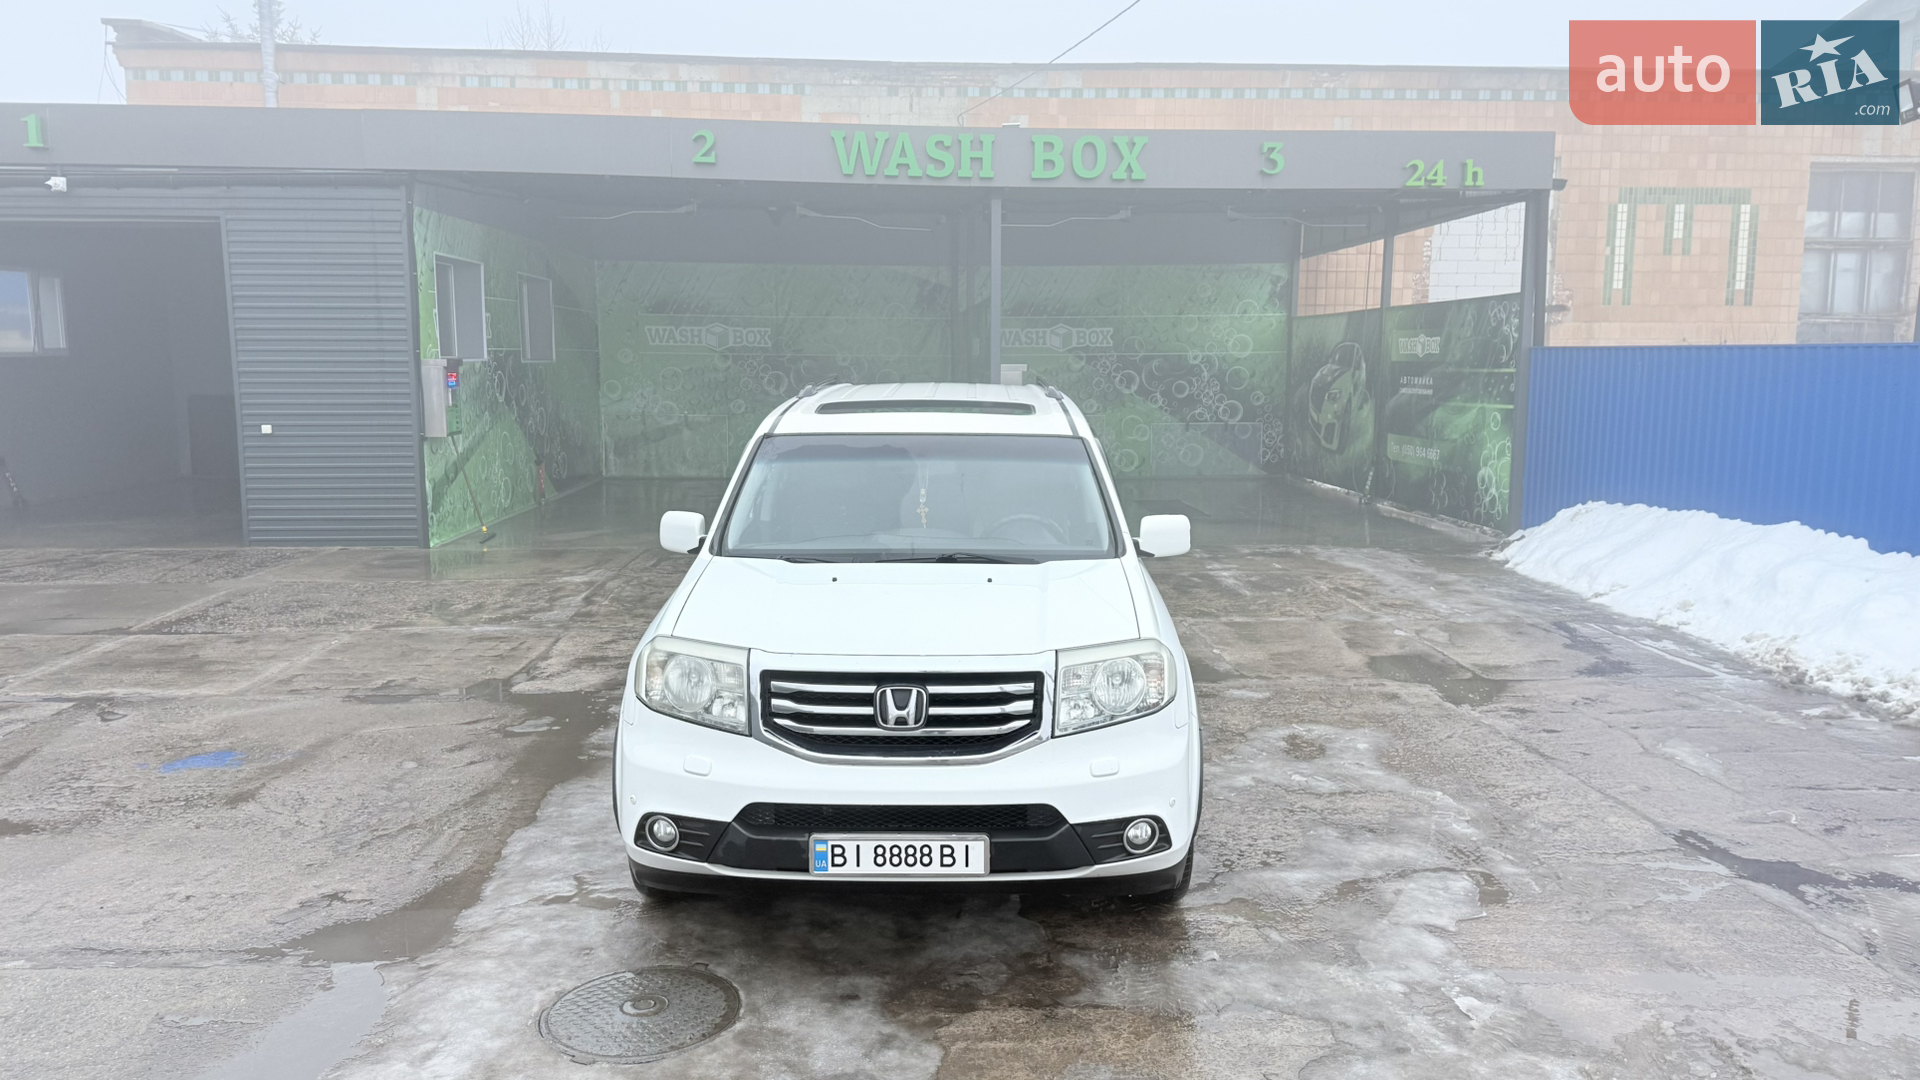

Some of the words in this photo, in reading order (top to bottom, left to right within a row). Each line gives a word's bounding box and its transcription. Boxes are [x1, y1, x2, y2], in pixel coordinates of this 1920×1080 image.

[20, 113, 46, 149] 1
[692, 129, 717, 164] 2
[831, 130, 996, 179] WASH
[1031, 133, 1149, 181] BOX
[1260, 141, 1286, 176] 3
[1405, 159, 1447, 187] 24
[1464, 158, 1486, 187] h
[645, 326, 704, 345] WASH
[731, 328, 771, 346] BOX
[1075, 328, 1113, 346] BOX
[1425, 337, 1440, 354] BOX
[815, 860, 827, 868] UA
[873, 844, 933, 868] 8888
